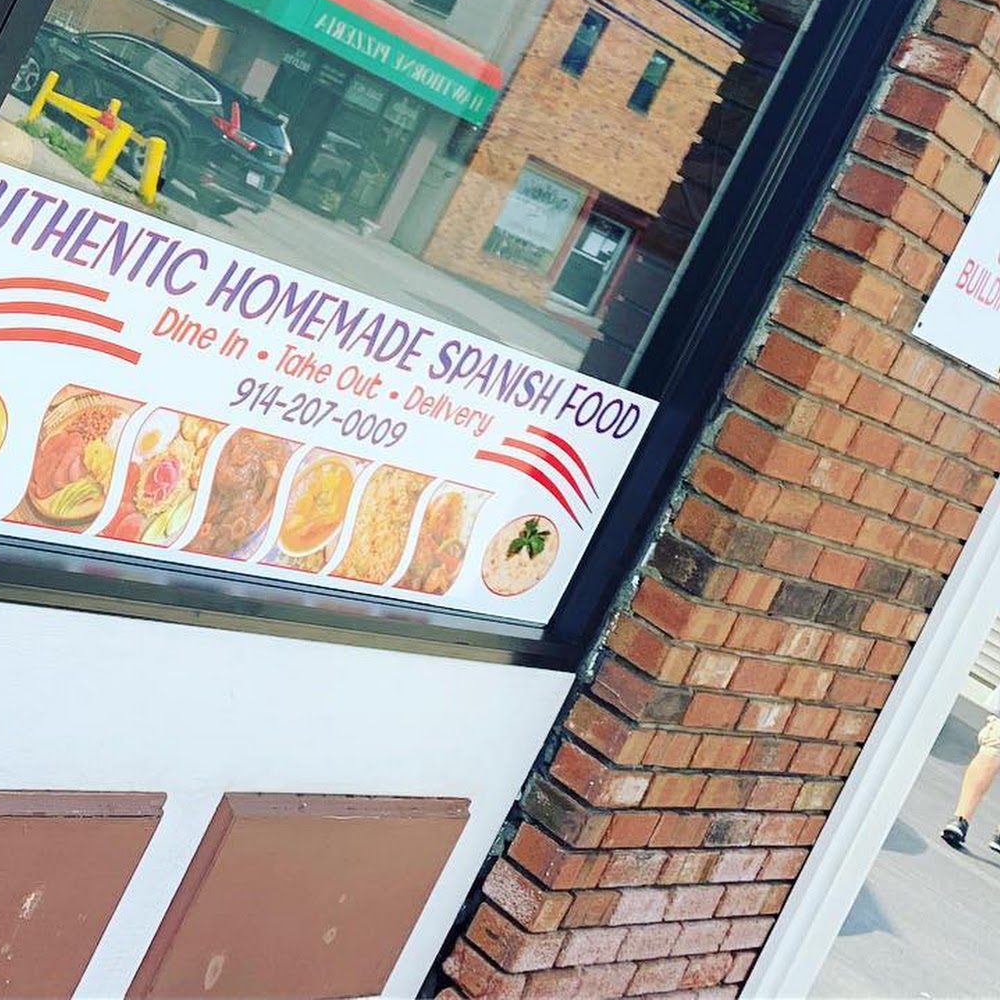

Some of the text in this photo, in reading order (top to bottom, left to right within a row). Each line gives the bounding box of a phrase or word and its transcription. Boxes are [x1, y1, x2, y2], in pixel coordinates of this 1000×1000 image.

[152, 305, 495, 438] Dine In Take Out Delivery
[205, 260, 434, 372] HOMEMADE
[428, 340, 565, 416] SPANISH
[555, 383, 641, 439] FOOD
[229, 377, 408, 448] 914-207-0009
